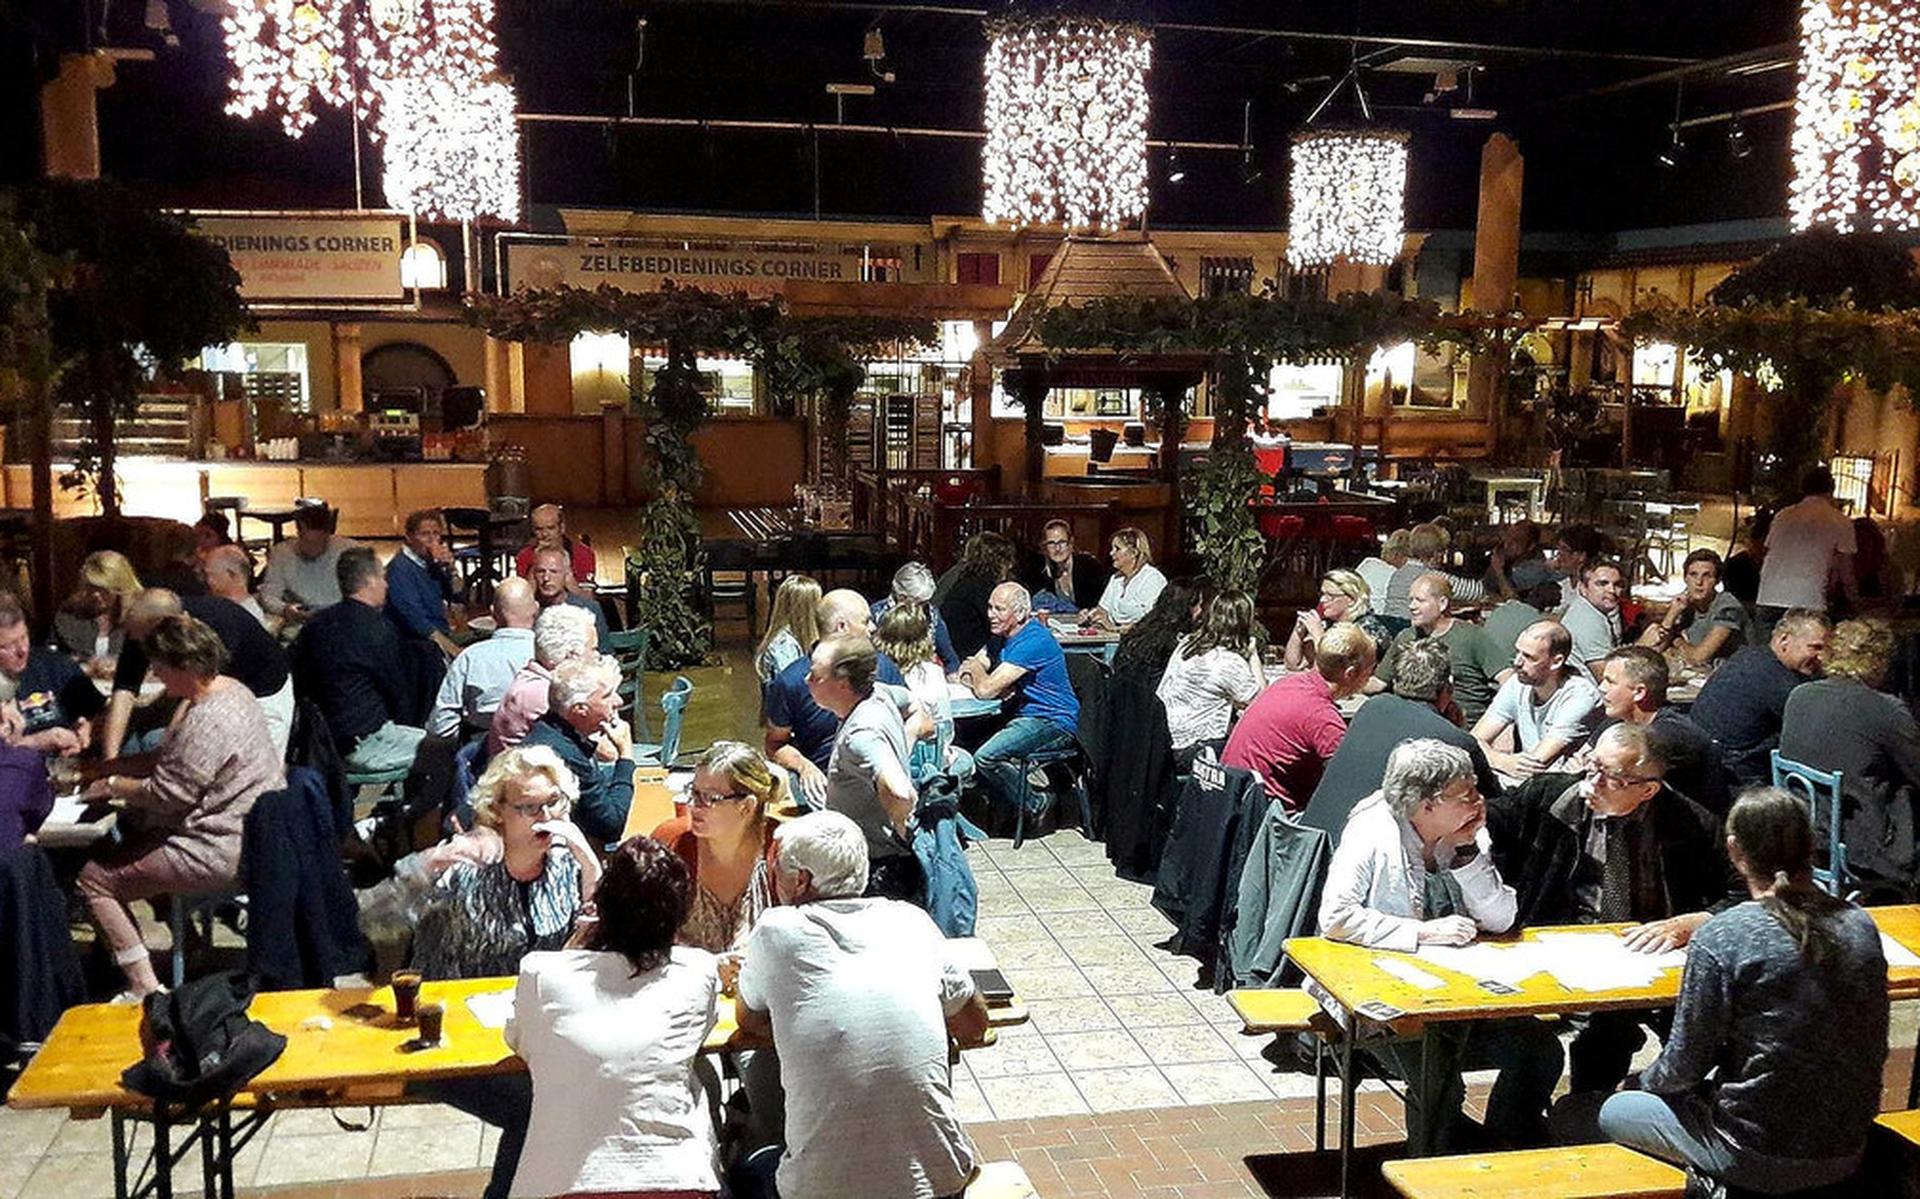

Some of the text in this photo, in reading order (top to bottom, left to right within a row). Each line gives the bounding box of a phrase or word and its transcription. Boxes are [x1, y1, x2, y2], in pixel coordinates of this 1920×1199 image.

[315, 236, 394, 252] CORNER
[580, 255, 842, 279] ZELFBEDIENINGS CORNER
